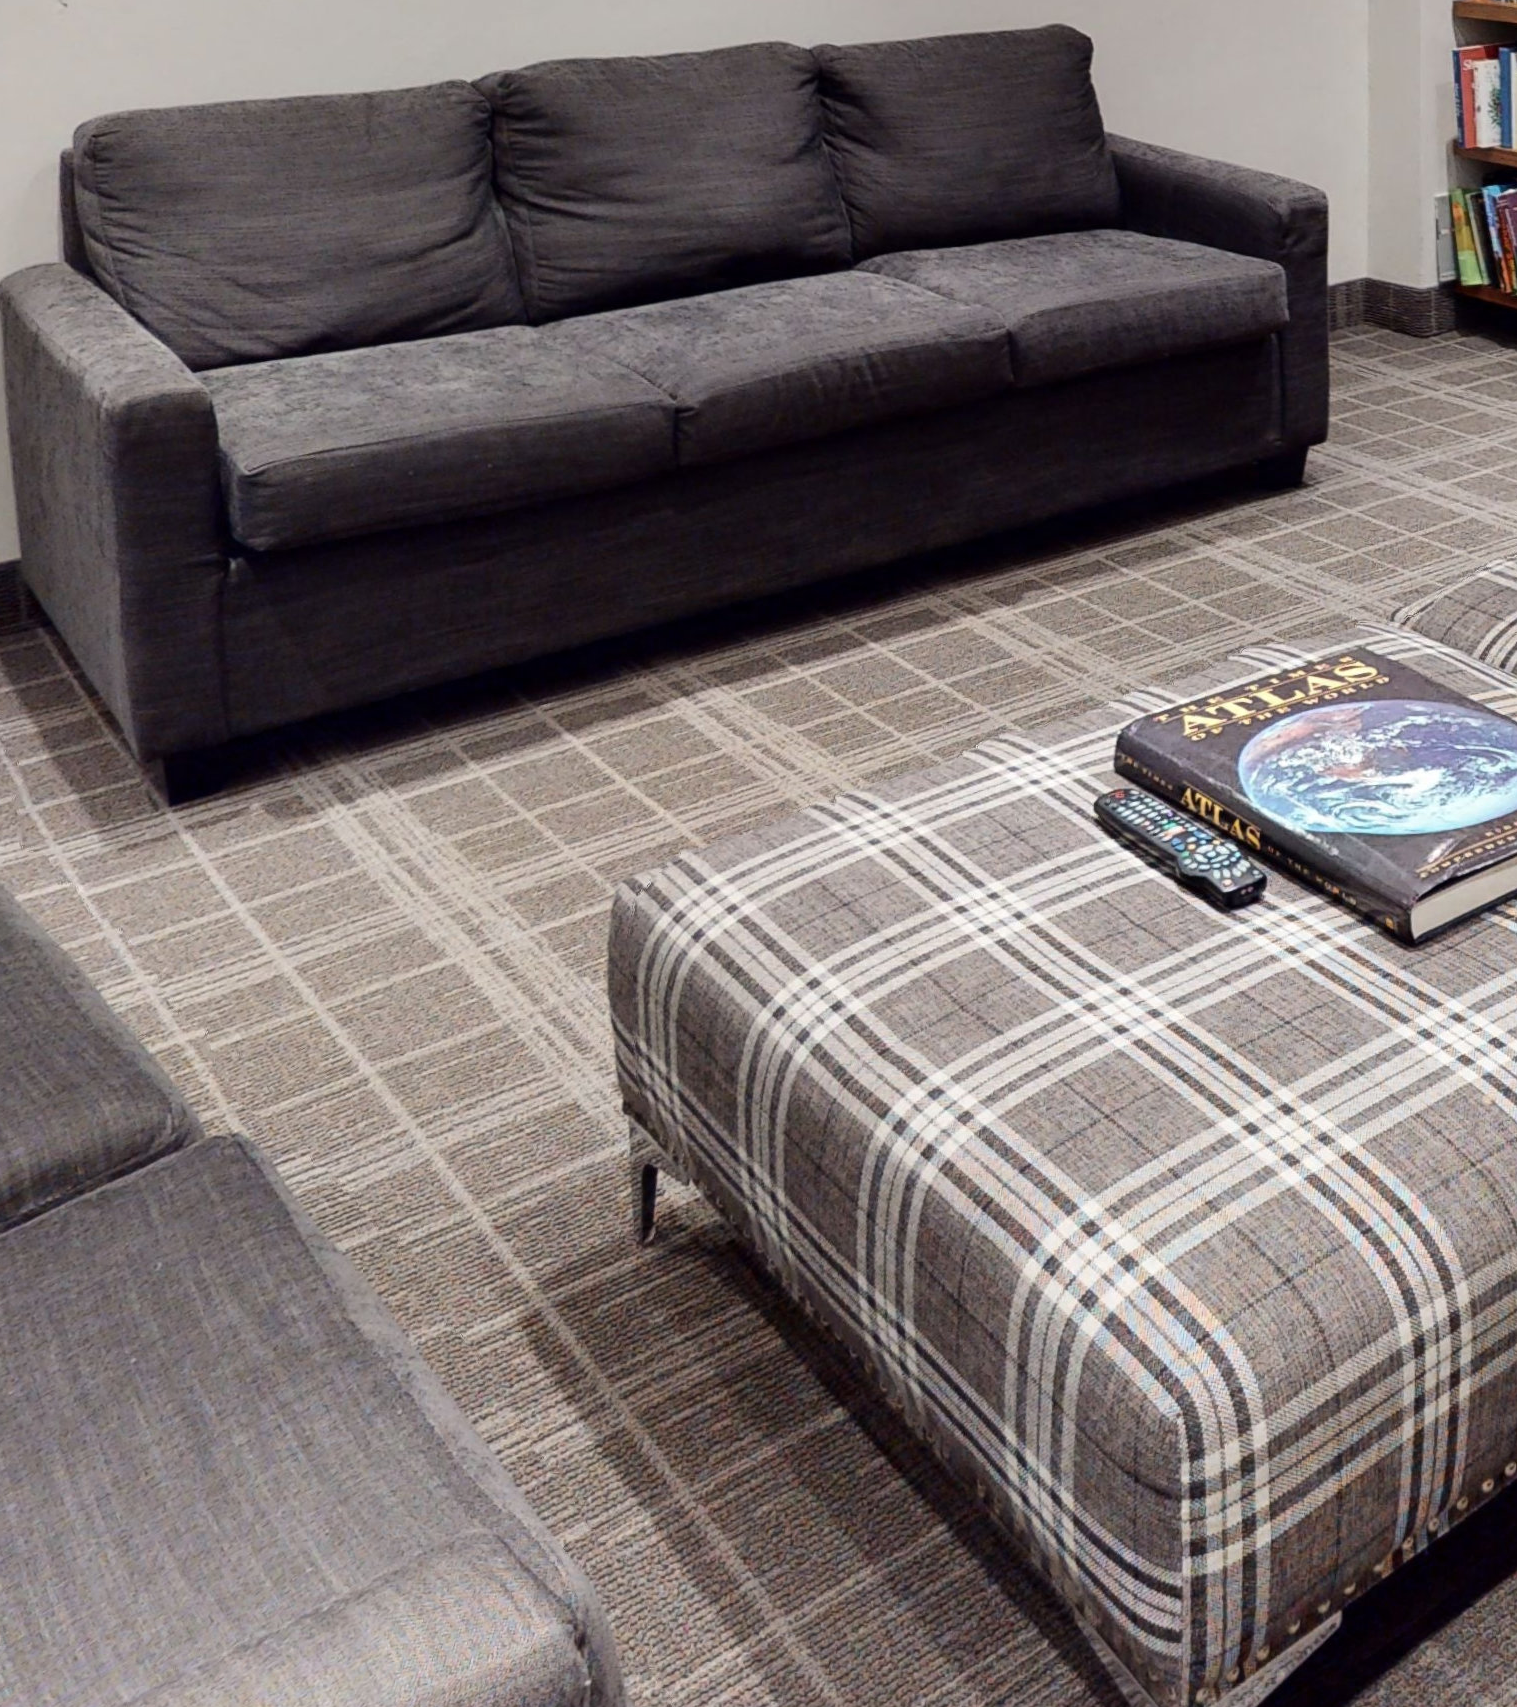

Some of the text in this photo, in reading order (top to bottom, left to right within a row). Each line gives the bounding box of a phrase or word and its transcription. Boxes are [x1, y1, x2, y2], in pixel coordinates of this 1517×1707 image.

[1182, 661, 1379, 737] ATLAS
[1190, 725, 1224, 742] OF
[1302, 675, 1390, 706] WORLD
[1180, 783, 1261, 851] ATLAS
